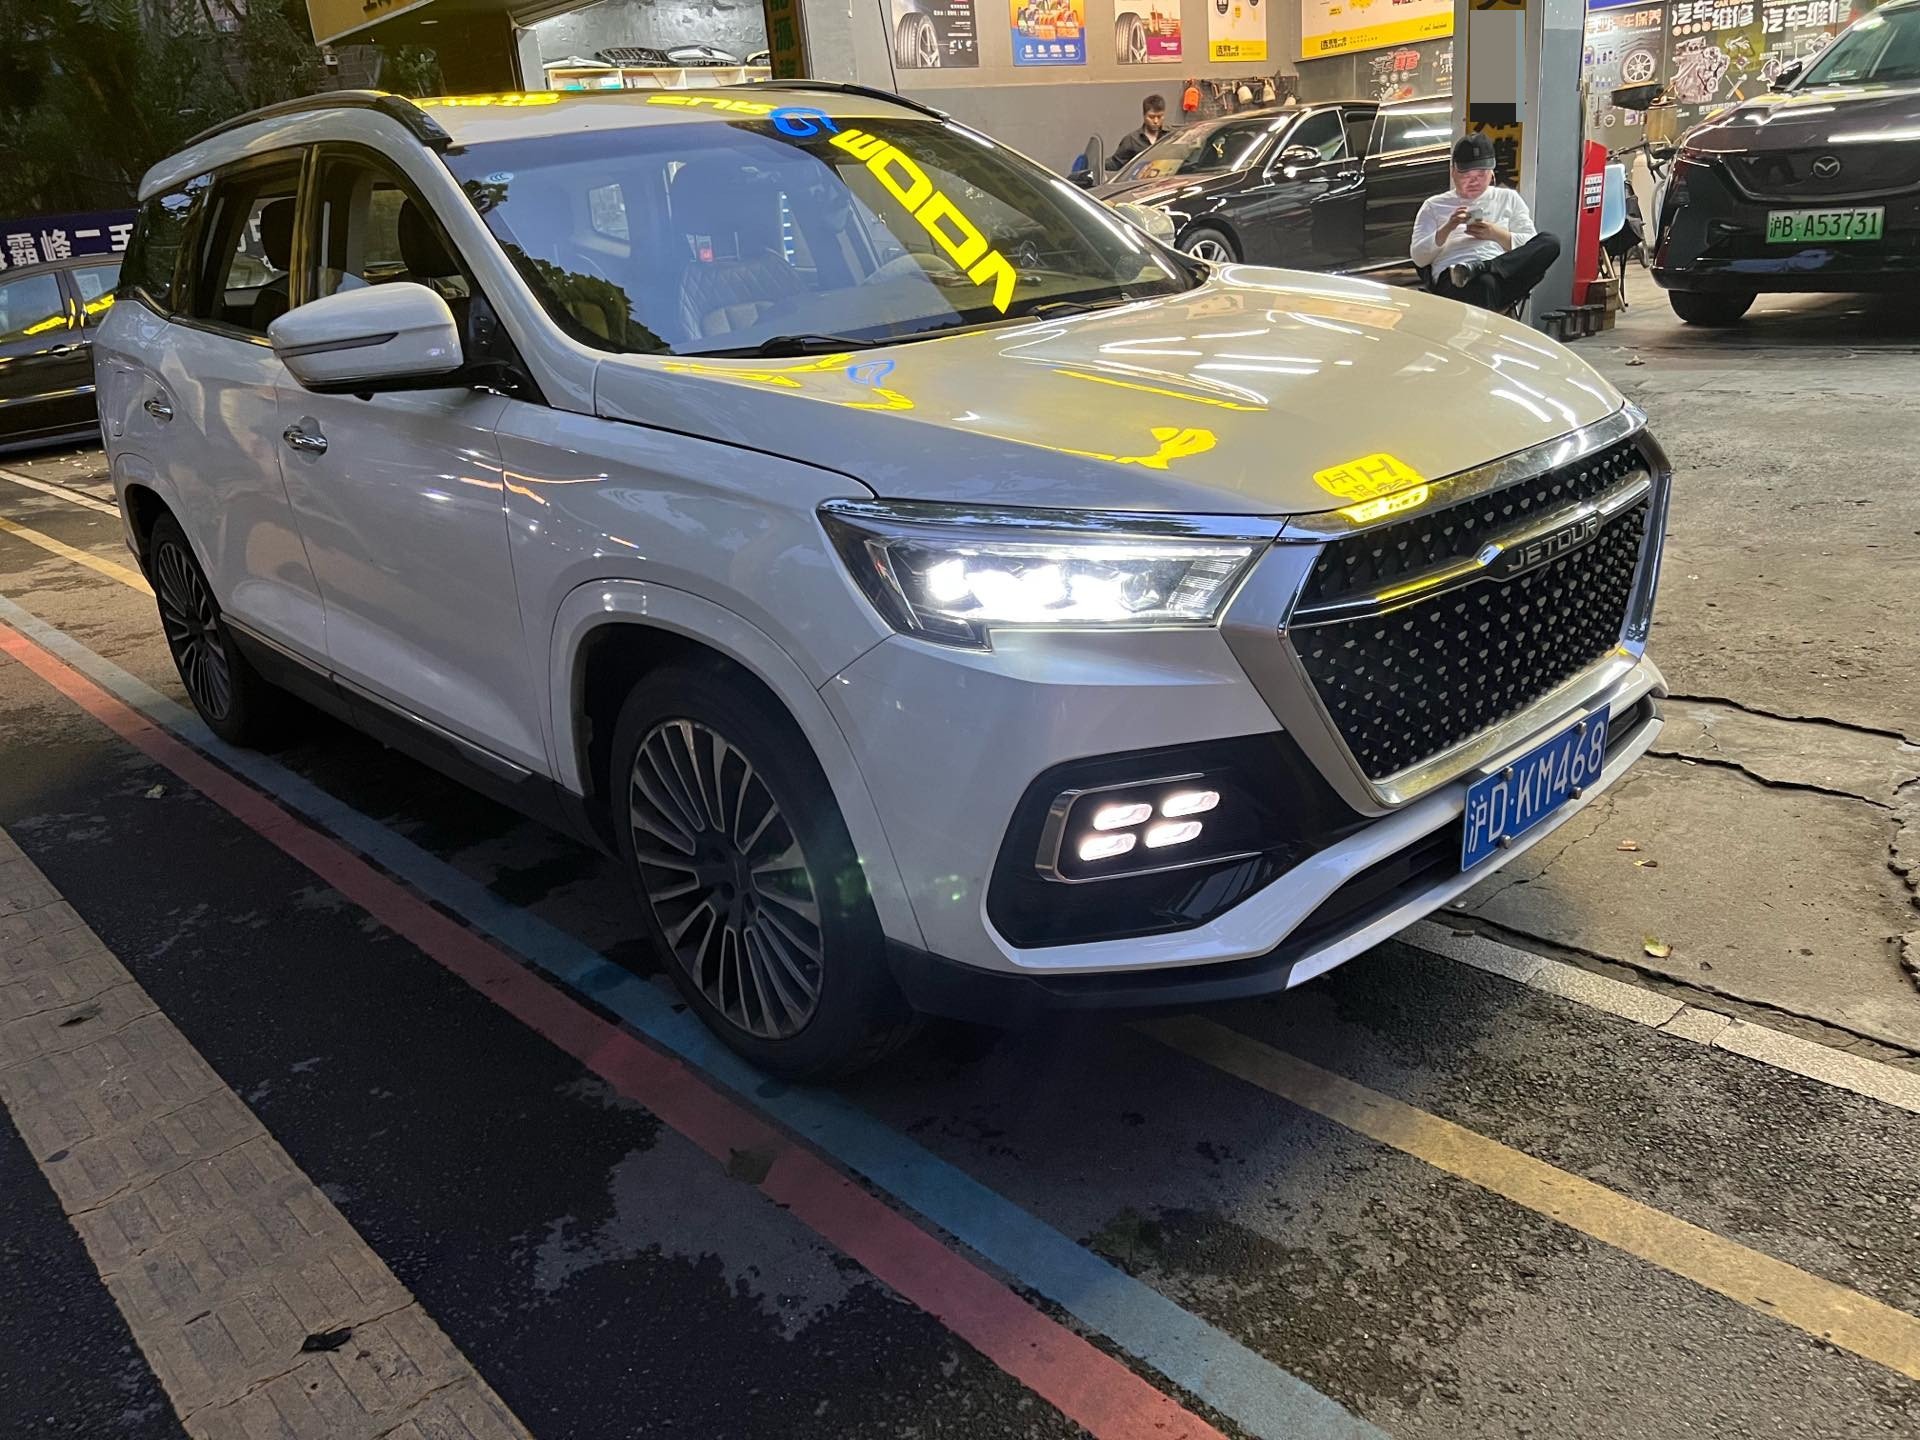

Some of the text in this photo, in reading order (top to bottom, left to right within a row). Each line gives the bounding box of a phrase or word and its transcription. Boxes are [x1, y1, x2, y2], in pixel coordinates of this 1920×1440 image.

[0, 223, 134, 270] 霸峰二手
[1507, 517, 1598, 572] JETOUR
